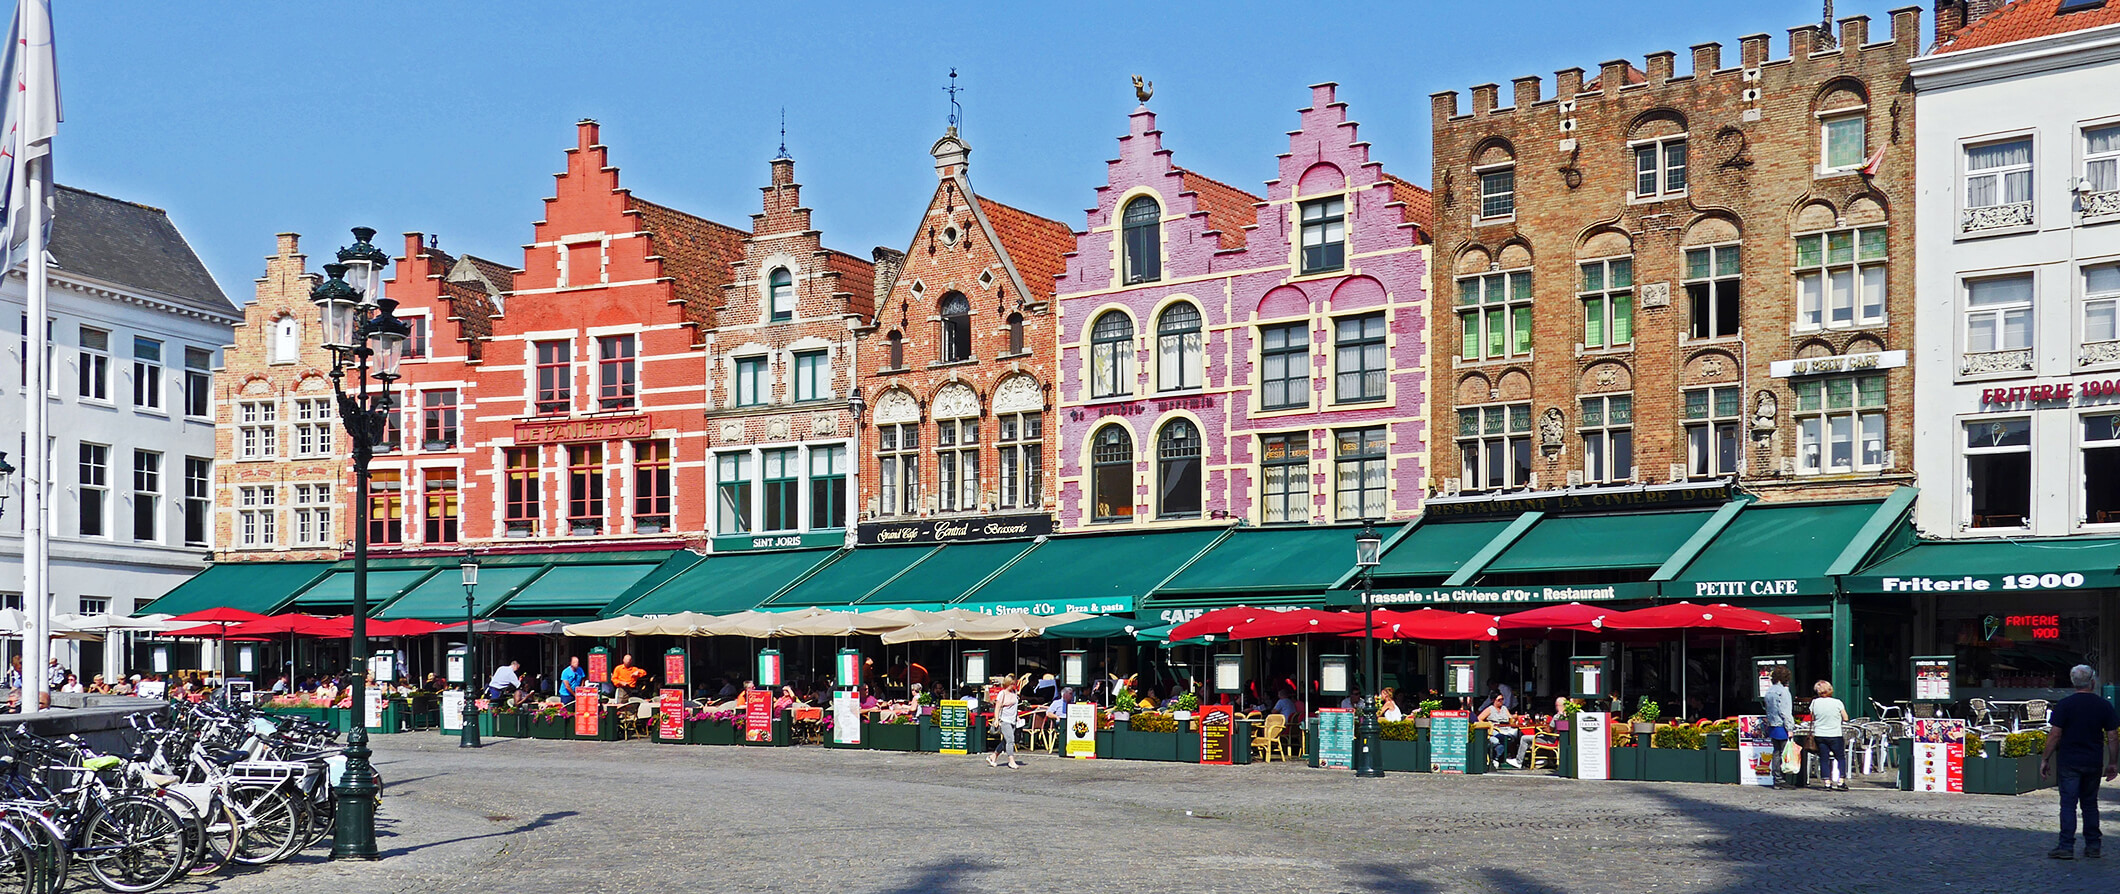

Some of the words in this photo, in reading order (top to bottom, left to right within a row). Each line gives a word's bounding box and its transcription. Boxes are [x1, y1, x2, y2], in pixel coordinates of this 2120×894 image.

[1793, 361, 1808, 373] AU
[1812, 357, 1846, 371] PETIT
[1848, 354, 1880, 367] CAFE
[1982, 383, 2073, 404] FRITERIE
[520, 429, 540, 442] LE
[544, 422, 604, 440] PANIER
[609, 419, 647, 436] D'OR
[1432, 498, 1548, 516] RESTAURANT
[1559, 496, 1583, 508] LA
[1592, 490, 1669, 506] CIVIERE
[1681, 487, 1726, 500] D'OR
[934, 521, 969, 541] Central
[984, 522, 1028, 535] Brasserie
[753, 538, 774, 547] SINT
[775, 536, 801, 547] JORIS
[1695, 581, 1746, 596] PETIT
[1750, 580, 1798, 595] CAFE
[1882, 576, 1991, 592] Friterie
[2002, 572, 2085, 589] 1900
[1433, 591, 1450, 602] La
[1452, 590, 1500, 602] Civiere
[1501, 589, 1531, 601] d'Or
[1543, 586, 1615, 600] Restaurant
[979, 606, 993, 616] La
[1032, 603, 1056, 614] d'Or
[1065, 604, 1089, 613] Pizza
[1090, 603, 1099, 612] &
[1101, 603, 1124, 614] pasta
[2006, 615, 2059, 626] FRITERIE
[2032, 628, 2059, 639] 1900
